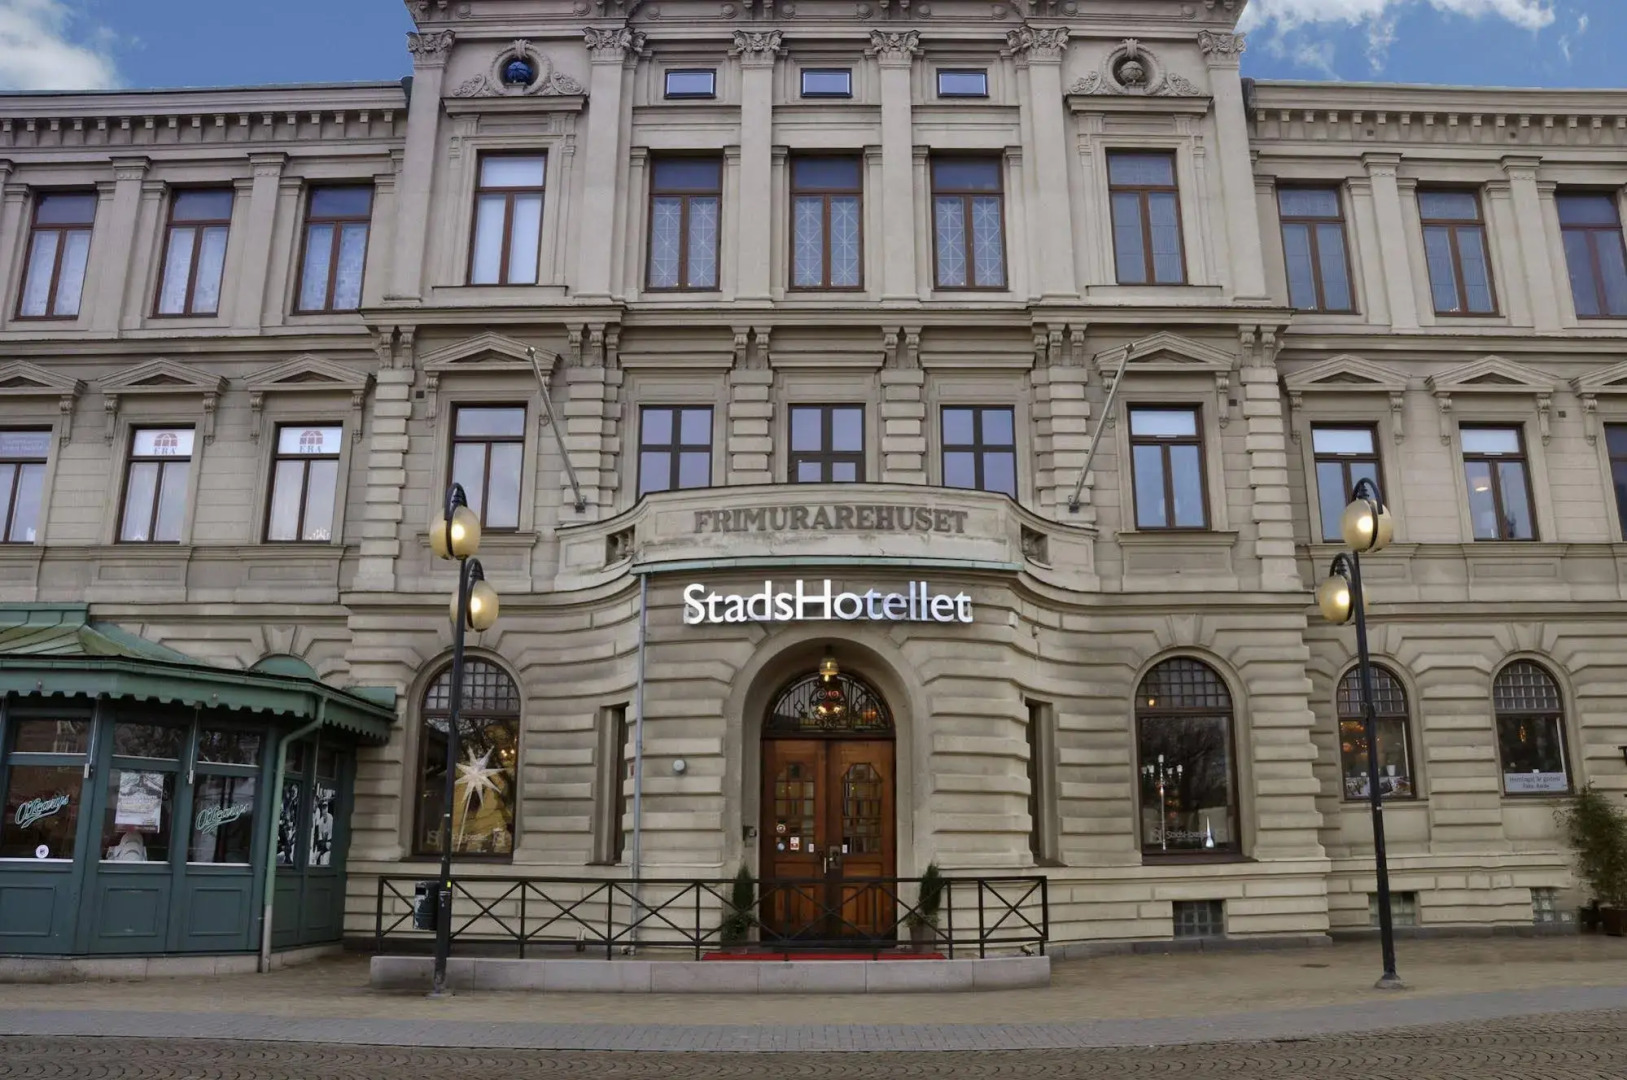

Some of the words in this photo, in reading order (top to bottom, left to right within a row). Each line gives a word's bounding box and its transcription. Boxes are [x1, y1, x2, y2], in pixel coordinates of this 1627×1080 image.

[153, 447, 177, 456] ERA
[298, 445, 322, 454] ERA
[693, 504, 968, 533] FRIMURAREHUSET
[683, 579, 973, 625] StadsHotellet
